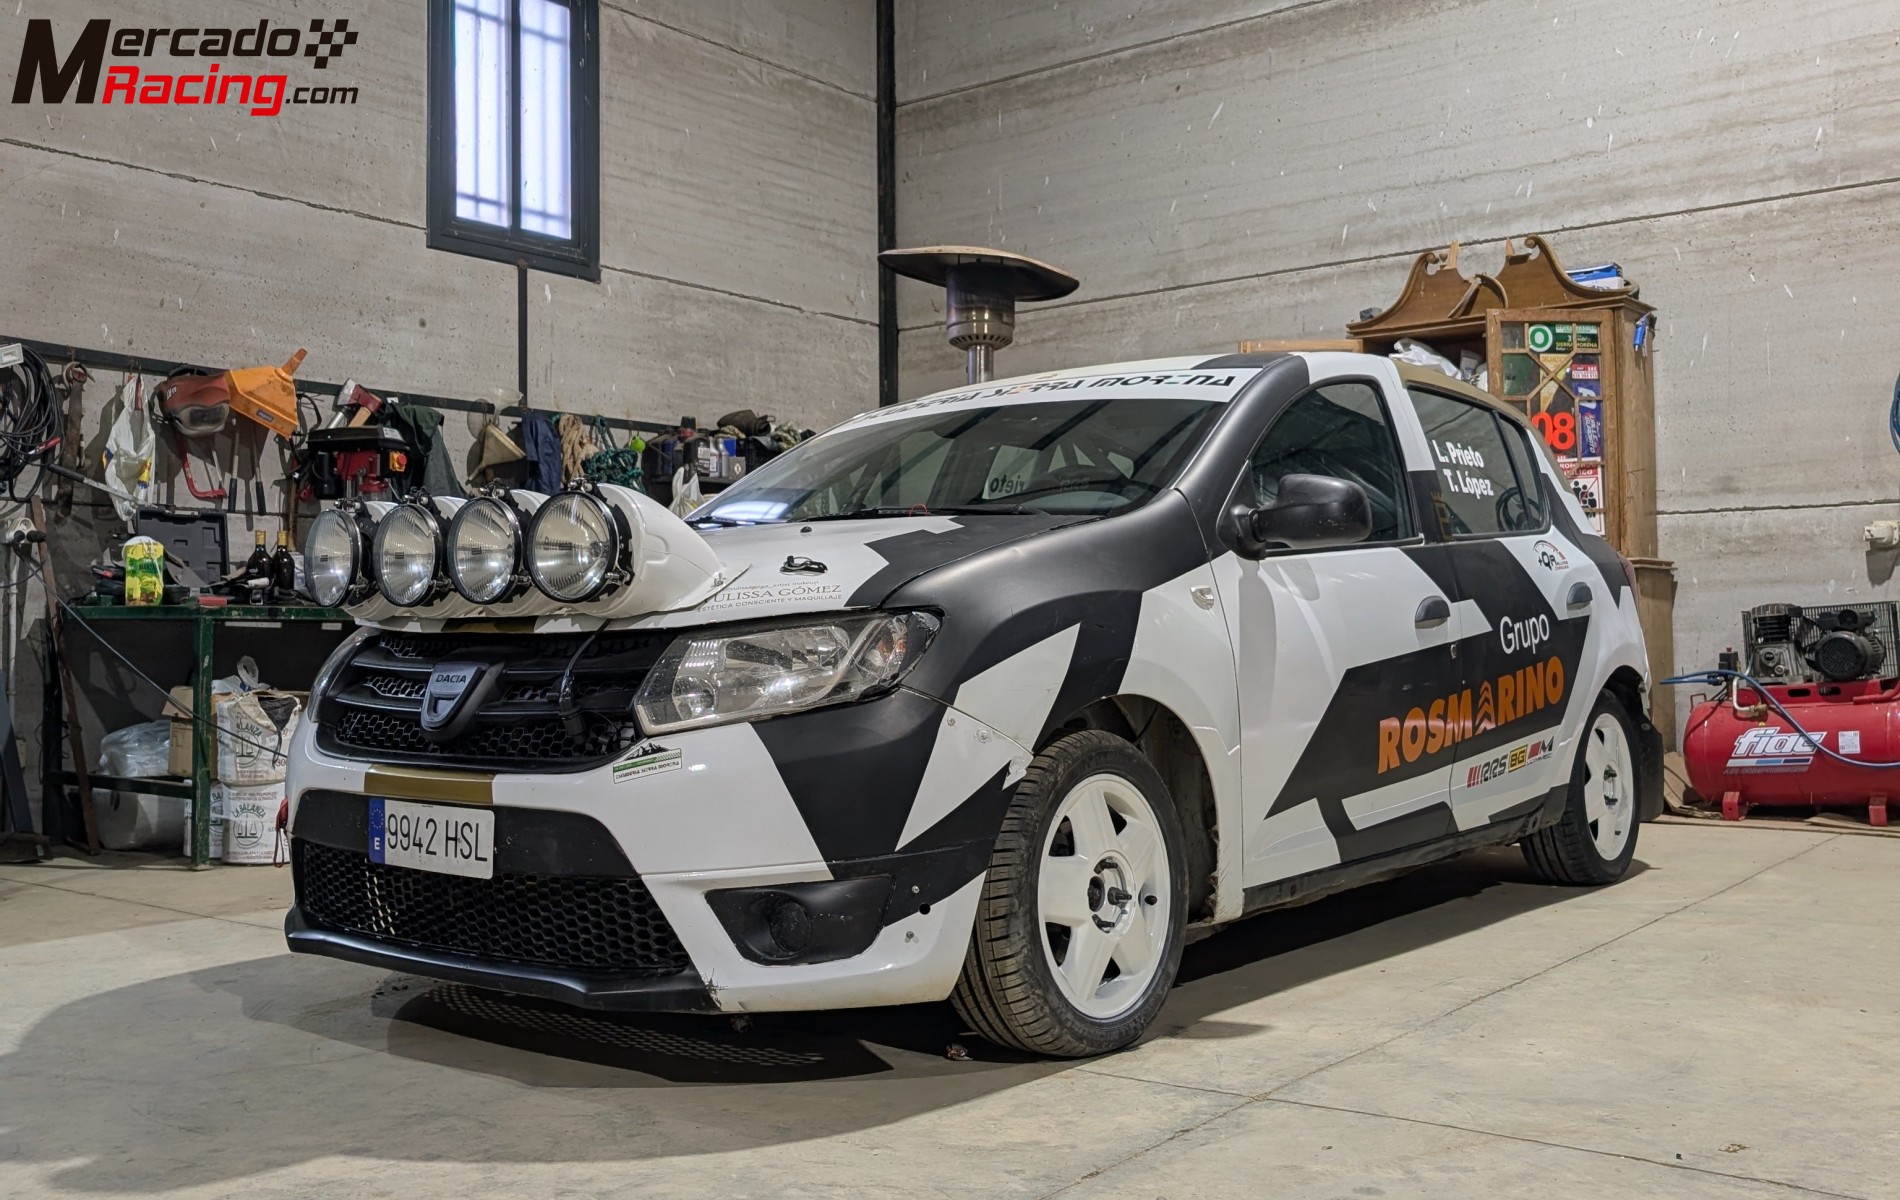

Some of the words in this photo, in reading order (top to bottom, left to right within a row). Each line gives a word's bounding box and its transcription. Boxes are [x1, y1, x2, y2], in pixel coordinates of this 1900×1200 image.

[1432, 439, 1449, 463] L.
[1445, 441, 1485, 468] Prieto
[1442, 468, 1459, 492] T.
[1456, 470, 1495, 500] López
[704, 588, 773, 603] ULISSA
[778, 584, 842, 597] GÓMEZ
[735, 598, 785, 608] CONSCIENTE
[794, 594, 842, 602] MAQUILLAJE
[1500, 613, 1550, 655] Grupo
[435, 674, 467, 684] DACIA
[1377, 655, 1565, 775] ROSMARINO
[1732, 726, 1827, 757] fiac
[374, 837, 381, 850] E
[387, 813, 437, 856] 9942
[445, 819, 488, 862] HSL
